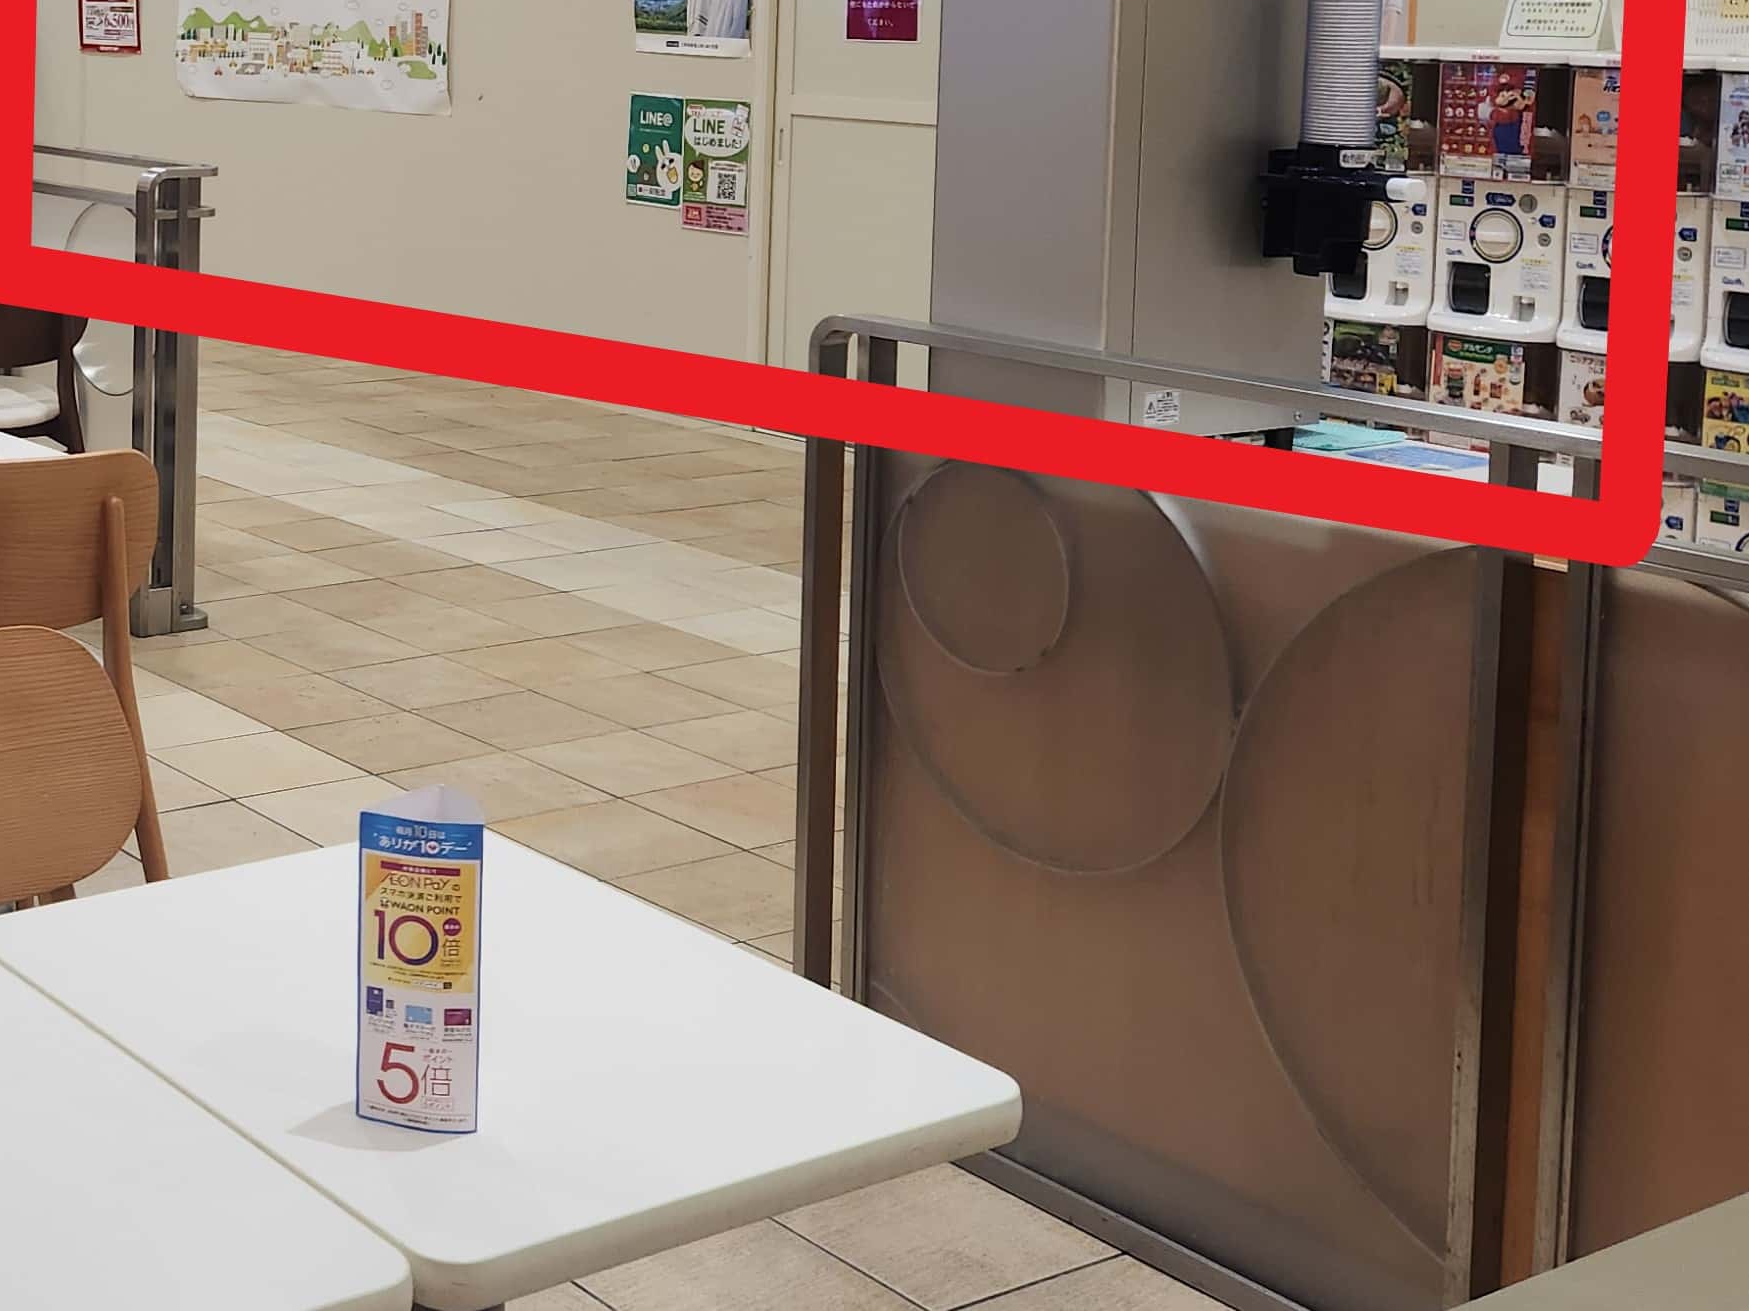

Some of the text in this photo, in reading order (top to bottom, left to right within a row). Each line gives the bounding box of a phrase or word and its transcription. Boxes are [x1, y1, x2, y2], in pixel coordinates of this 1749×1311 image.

[640, 110, 673, 127] LINE@
[693, 119, 725, 134] LINE
[391, 900, 460, 916] WAON POINT
